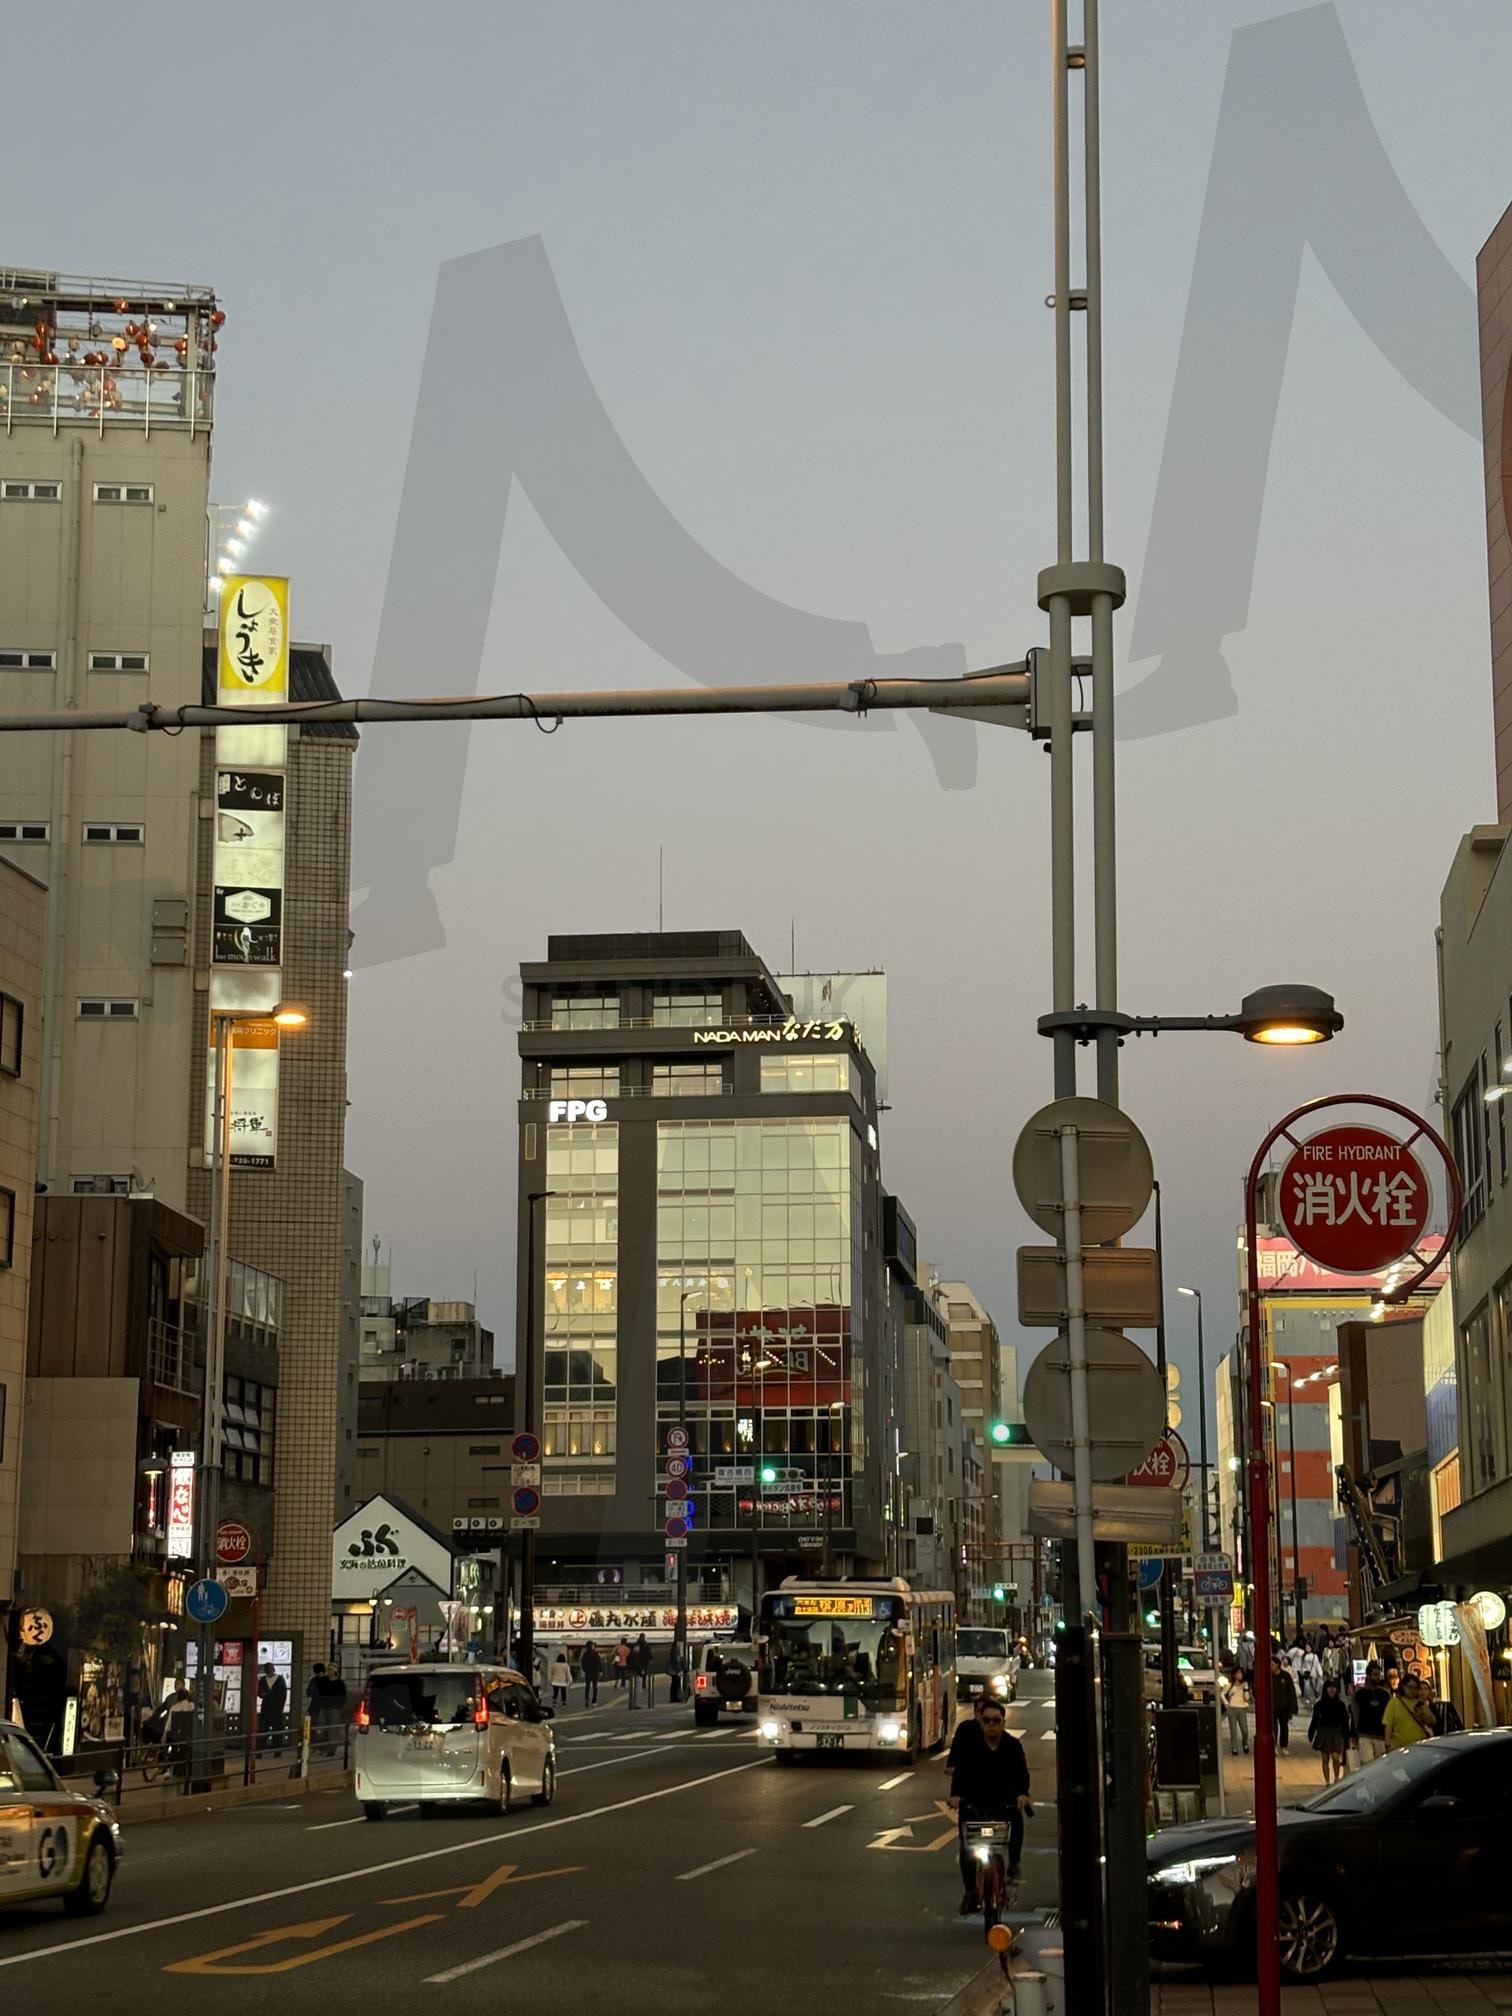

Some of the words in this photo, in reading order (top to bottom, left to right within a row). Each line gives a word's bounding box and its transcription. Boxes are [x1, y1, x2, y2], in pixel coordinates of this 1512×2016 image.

[693, 1030, 741, 1044] NADA
[742, 1029, 781, 1042] MAN
[549, 1100, 608, 1122] FPG
[1303, 1145, 1333, 1160] FIRE
[1338, 1145, 1402, 1160] HYDRANT
[1292, 1171, 1418, 1226] 消火栓
[671, 1462, 683, 1473] 40
[348, 1523, 400, 1557] ふぐ
